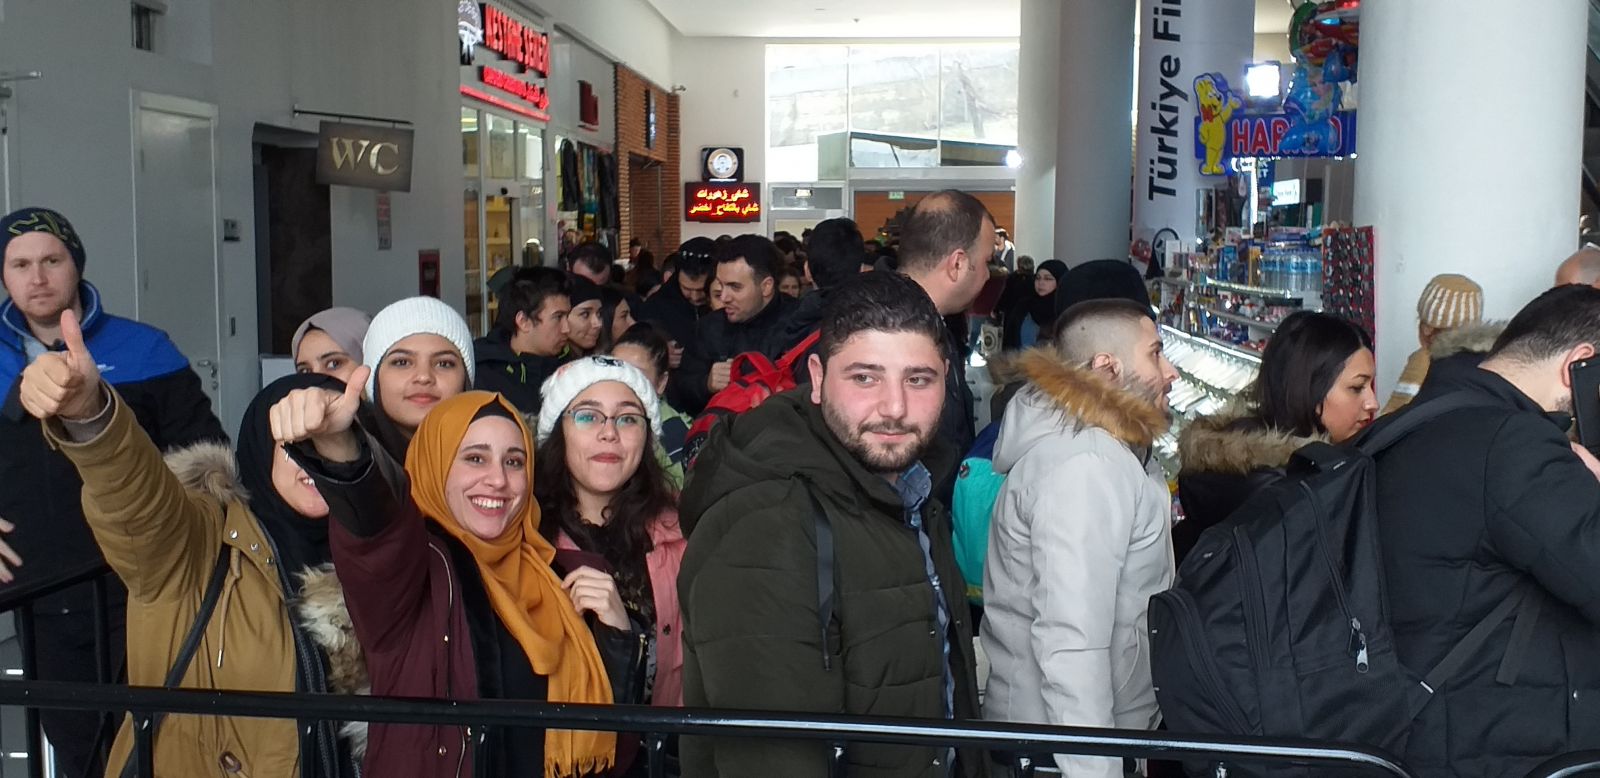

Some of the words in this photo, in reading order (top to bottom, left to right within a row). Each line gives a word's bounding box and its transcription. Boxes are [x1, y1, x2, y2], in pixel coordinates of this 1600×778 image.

[1153, 0, 1181, 42] Fi
[1148, 54, 1189, 201] Türkiye
[330, 137, 400, 176] WC
